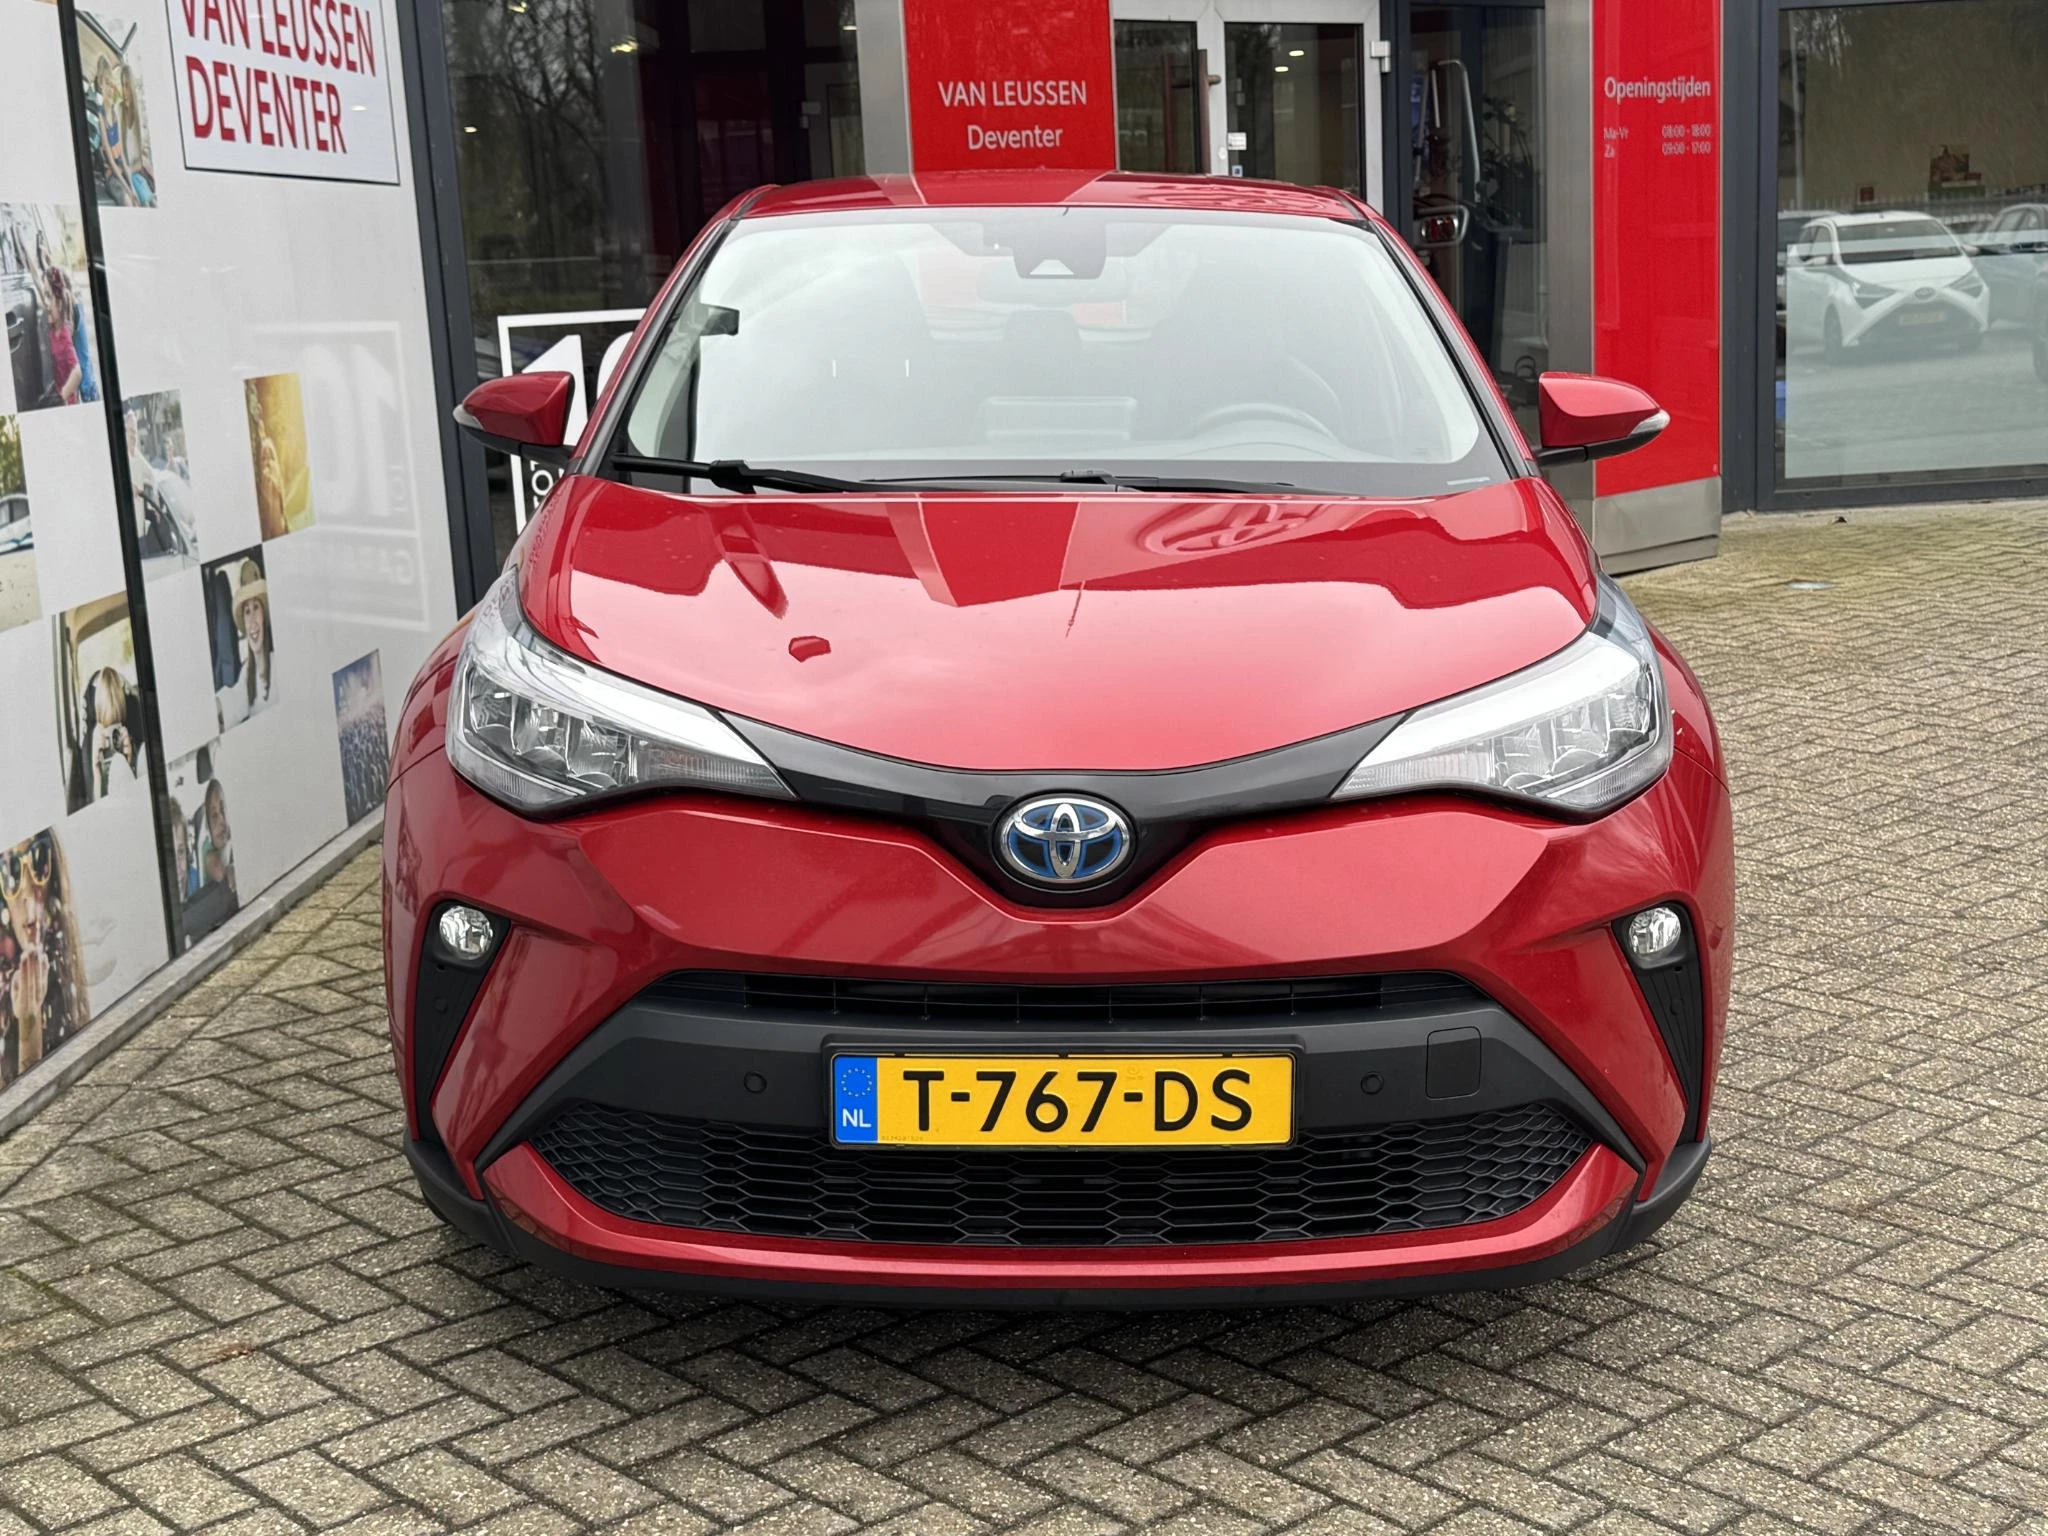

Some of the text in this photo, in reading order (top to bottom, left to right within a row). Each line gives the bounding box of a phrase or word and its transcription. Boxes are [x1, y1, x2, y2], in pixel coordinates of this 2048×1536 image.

[257, 0, 376, 78] LEUSSEN
[185, 55, 348, 155] DEVENTER
[937, 80, 1087, 107] VAN LEUSSEN
[1604, 76, 1711, 104] Openingstijden
[967, 124, 1063, 150] Deventer
[521, 331, 633, 447] 1
[842, 1108, 872, 1128] NL
[903, 1069, 1252, 1133] T-767-DS
